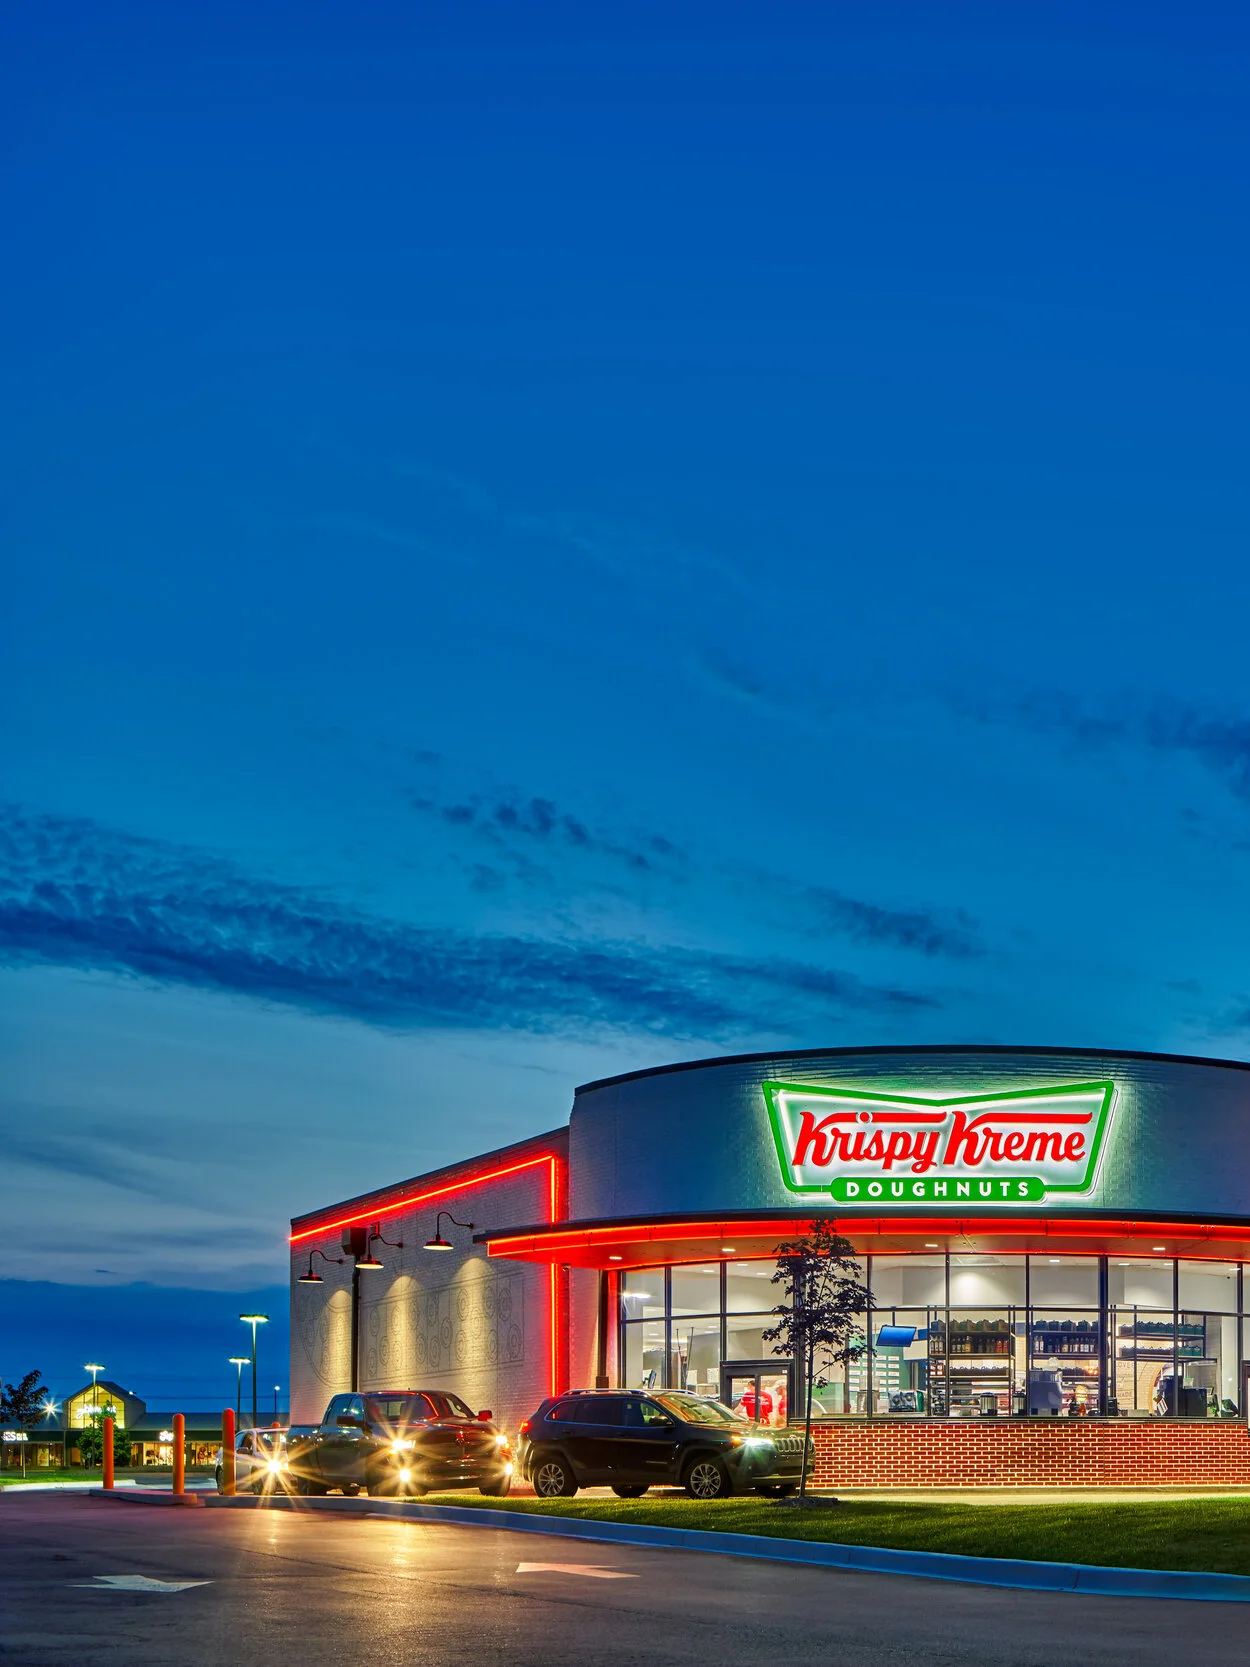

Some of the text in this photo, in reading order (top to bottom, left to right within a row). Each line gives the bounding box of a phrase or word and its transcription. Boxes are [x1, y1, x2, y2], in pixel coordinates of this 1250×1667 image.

[791, 1111, 1093, 1174] Krispy Kreme
[846, 1181, 1029, 1197] DOUGHNUTS
